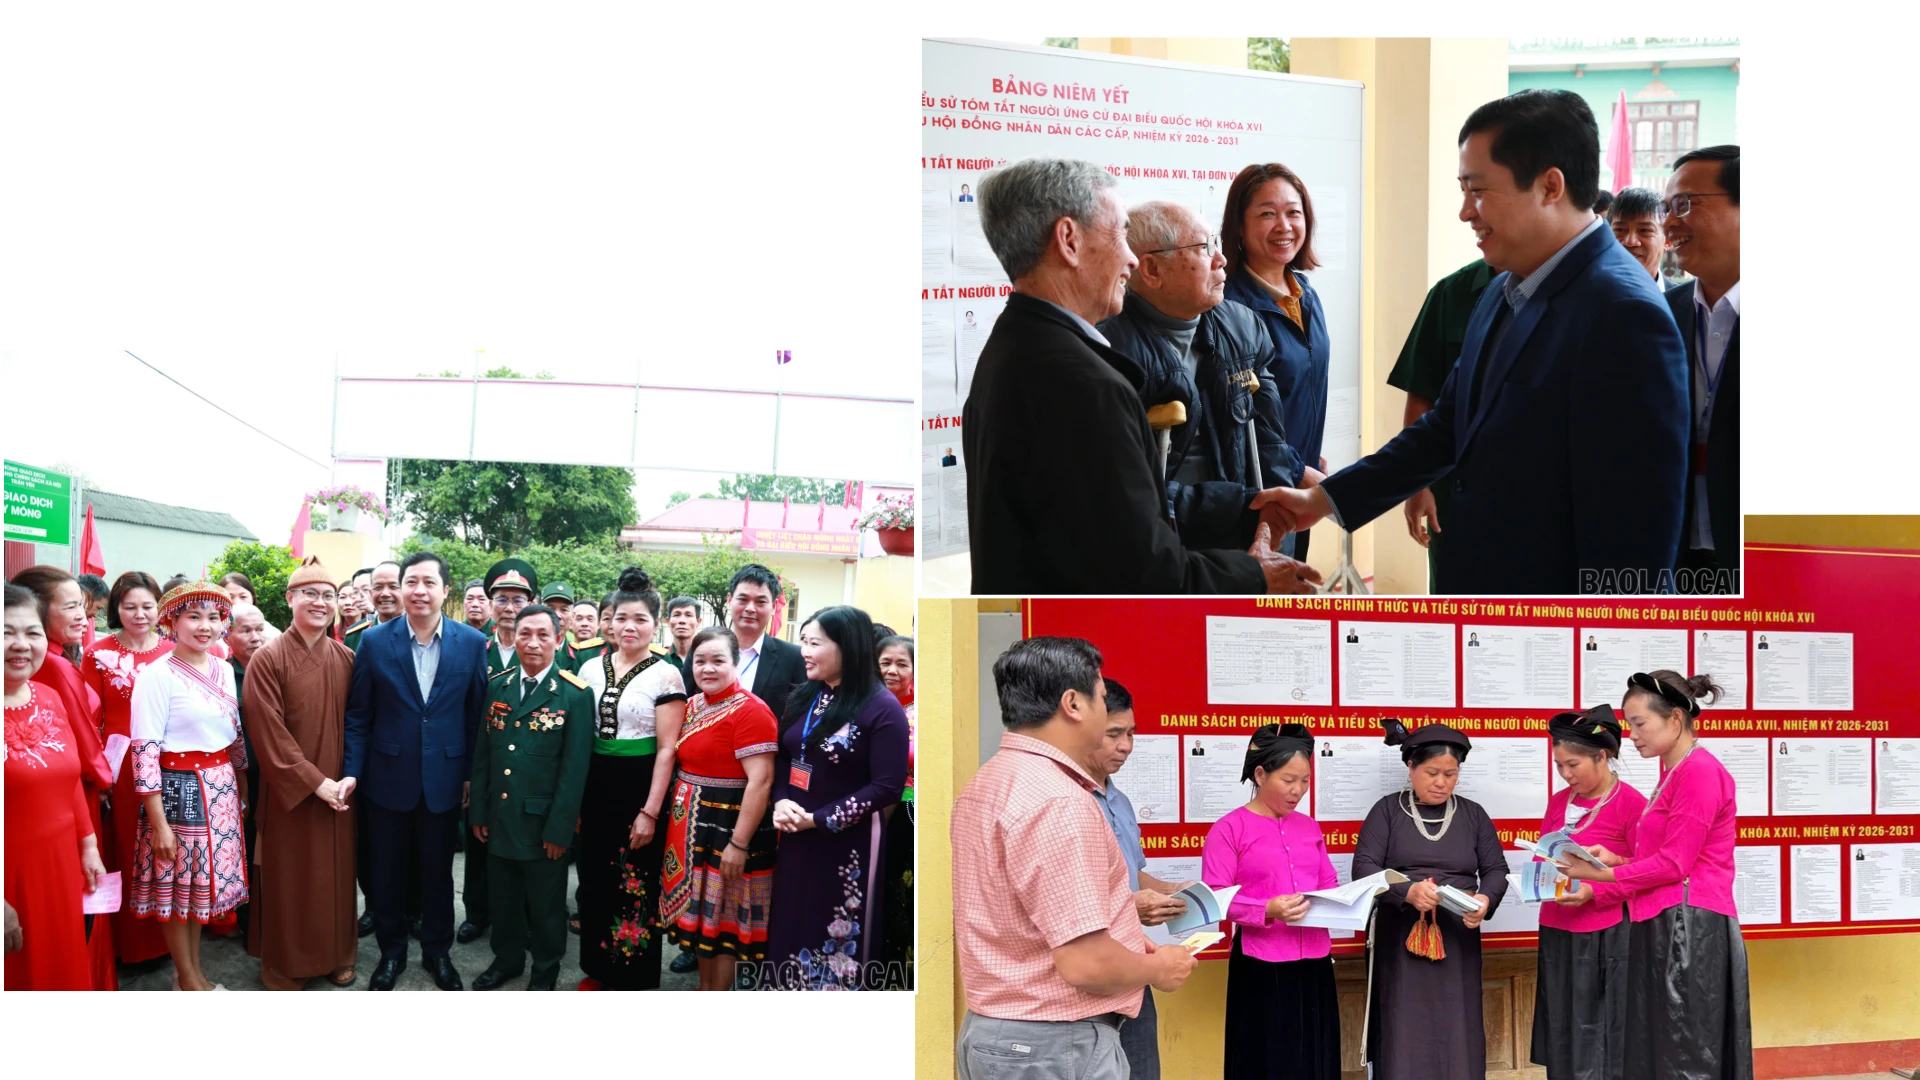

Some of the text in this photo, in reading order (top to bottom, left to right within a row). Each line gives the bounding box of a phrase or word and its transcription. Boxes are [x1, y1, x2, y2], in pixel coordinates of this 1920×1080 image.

[992, 74, 1130, 104] BẢNG NIÊM YẾT
[940, 94, 957, 109] SỬ
[961, 98, 990, 112] TÓM
[994, 98, 1015, 113] TẮT
[1020, 103, 1060, 117] NGƯỜI
[1064, 106, 1089, 120] ỨNG
[1093, 108, 1109, 121] CỬ
[1112, 112, 1132, 125] ĐẠI
[1135, 110, 1157, 124] BIỂU
[1160, 113, 1192, 127] QUỐC
[1196, 117, 1212, 129] HỘI
[1216, 119, 1244, 131] KHÓA
[1247, 122, 1262, 132] XVI
[932, 115, 956, 130] HỘI
[961, 115, 1002, 131] ĐỒNG
[1007, 121, 1042, 134] NHÂN
[1047, 123, 1071, 136] DÂN
[1075, 126, 1101, 138] CÁC
[1105, 126, 1130, 141] CẤP,
[1133, 129, 1166, 143] NHIỆM
[1186, 134, 1209, 144] 2026
[1217, 136, 1239, 146] 2031
[930, 153, 953, 169] TẮT
[957, 156, 994, 170] NGƯỜI
[1124, 165, 1141, 180] HỘI
[1192, 171, 1206, 182] TẠI
[1208, 170, 1226, 181] ĐƠN
[933, 284, 954, 300] TẮT
[959, 284, 996, 299] NGƯỜI
[999, 283, 1017, 297] ỨN
[928, 413, 950, 430] TẮT
[30, 496, 54, 509] DỊCH
[1377, 598, 1409, 613] THỨC
[1412, 600, 1428, 614] VÀ
[1431, 598, 1458, 615] TIỂU
[1461, 599, 1478, 615] SỬ
[1480, 602, 1505, 616] TÓM
[1508, 602, 1529, 617] TẮT
[1532, 603, 1574, 618] NHỮNG
[1577, 604, 1613, 619] NGƯỜI
[1615, 605, 1639, 619] ỨNG
[1642, 604, 1659, 620] CỬ
[1660, 608, 1680, 623] ĐẠI
[1682, 605, 1708, 621] BIỂU
[1711, 606, 1741, 622] QUỐC
[1744, 608, 1763, 625] HỘI
[1765, 609, 1794, 623] KHÓA
[1797, 612, 1815, 623] XVI
[1160, 714, 1198, 727] DANH
[1201, 712, 1237, 728] SÁCH
[1319, 714, 1335, 728] VÀ
[1338, 712, 1365, 729] TIỂU
[1484, 715, 1520, 730] NGƯỜI
[1523, 715, 1549, 730] ỨNG
[1703, 719, 1722, 731] CAI
[1724, 717, 1753, 731] KHÓA
[1756, 720, 1781, 732] XVII,
[1783, 718, 1818, 733] NHIỆM
[1836, 720, 1889, 731] 2026-2031
[1740, 825, 1771, 839] KHÓA
[1773, 826, 1801, 839] XXII,
[1803, 824, 1839, 840] NHIỆM
[1858, 825, 1915, 837] 2026-2031
